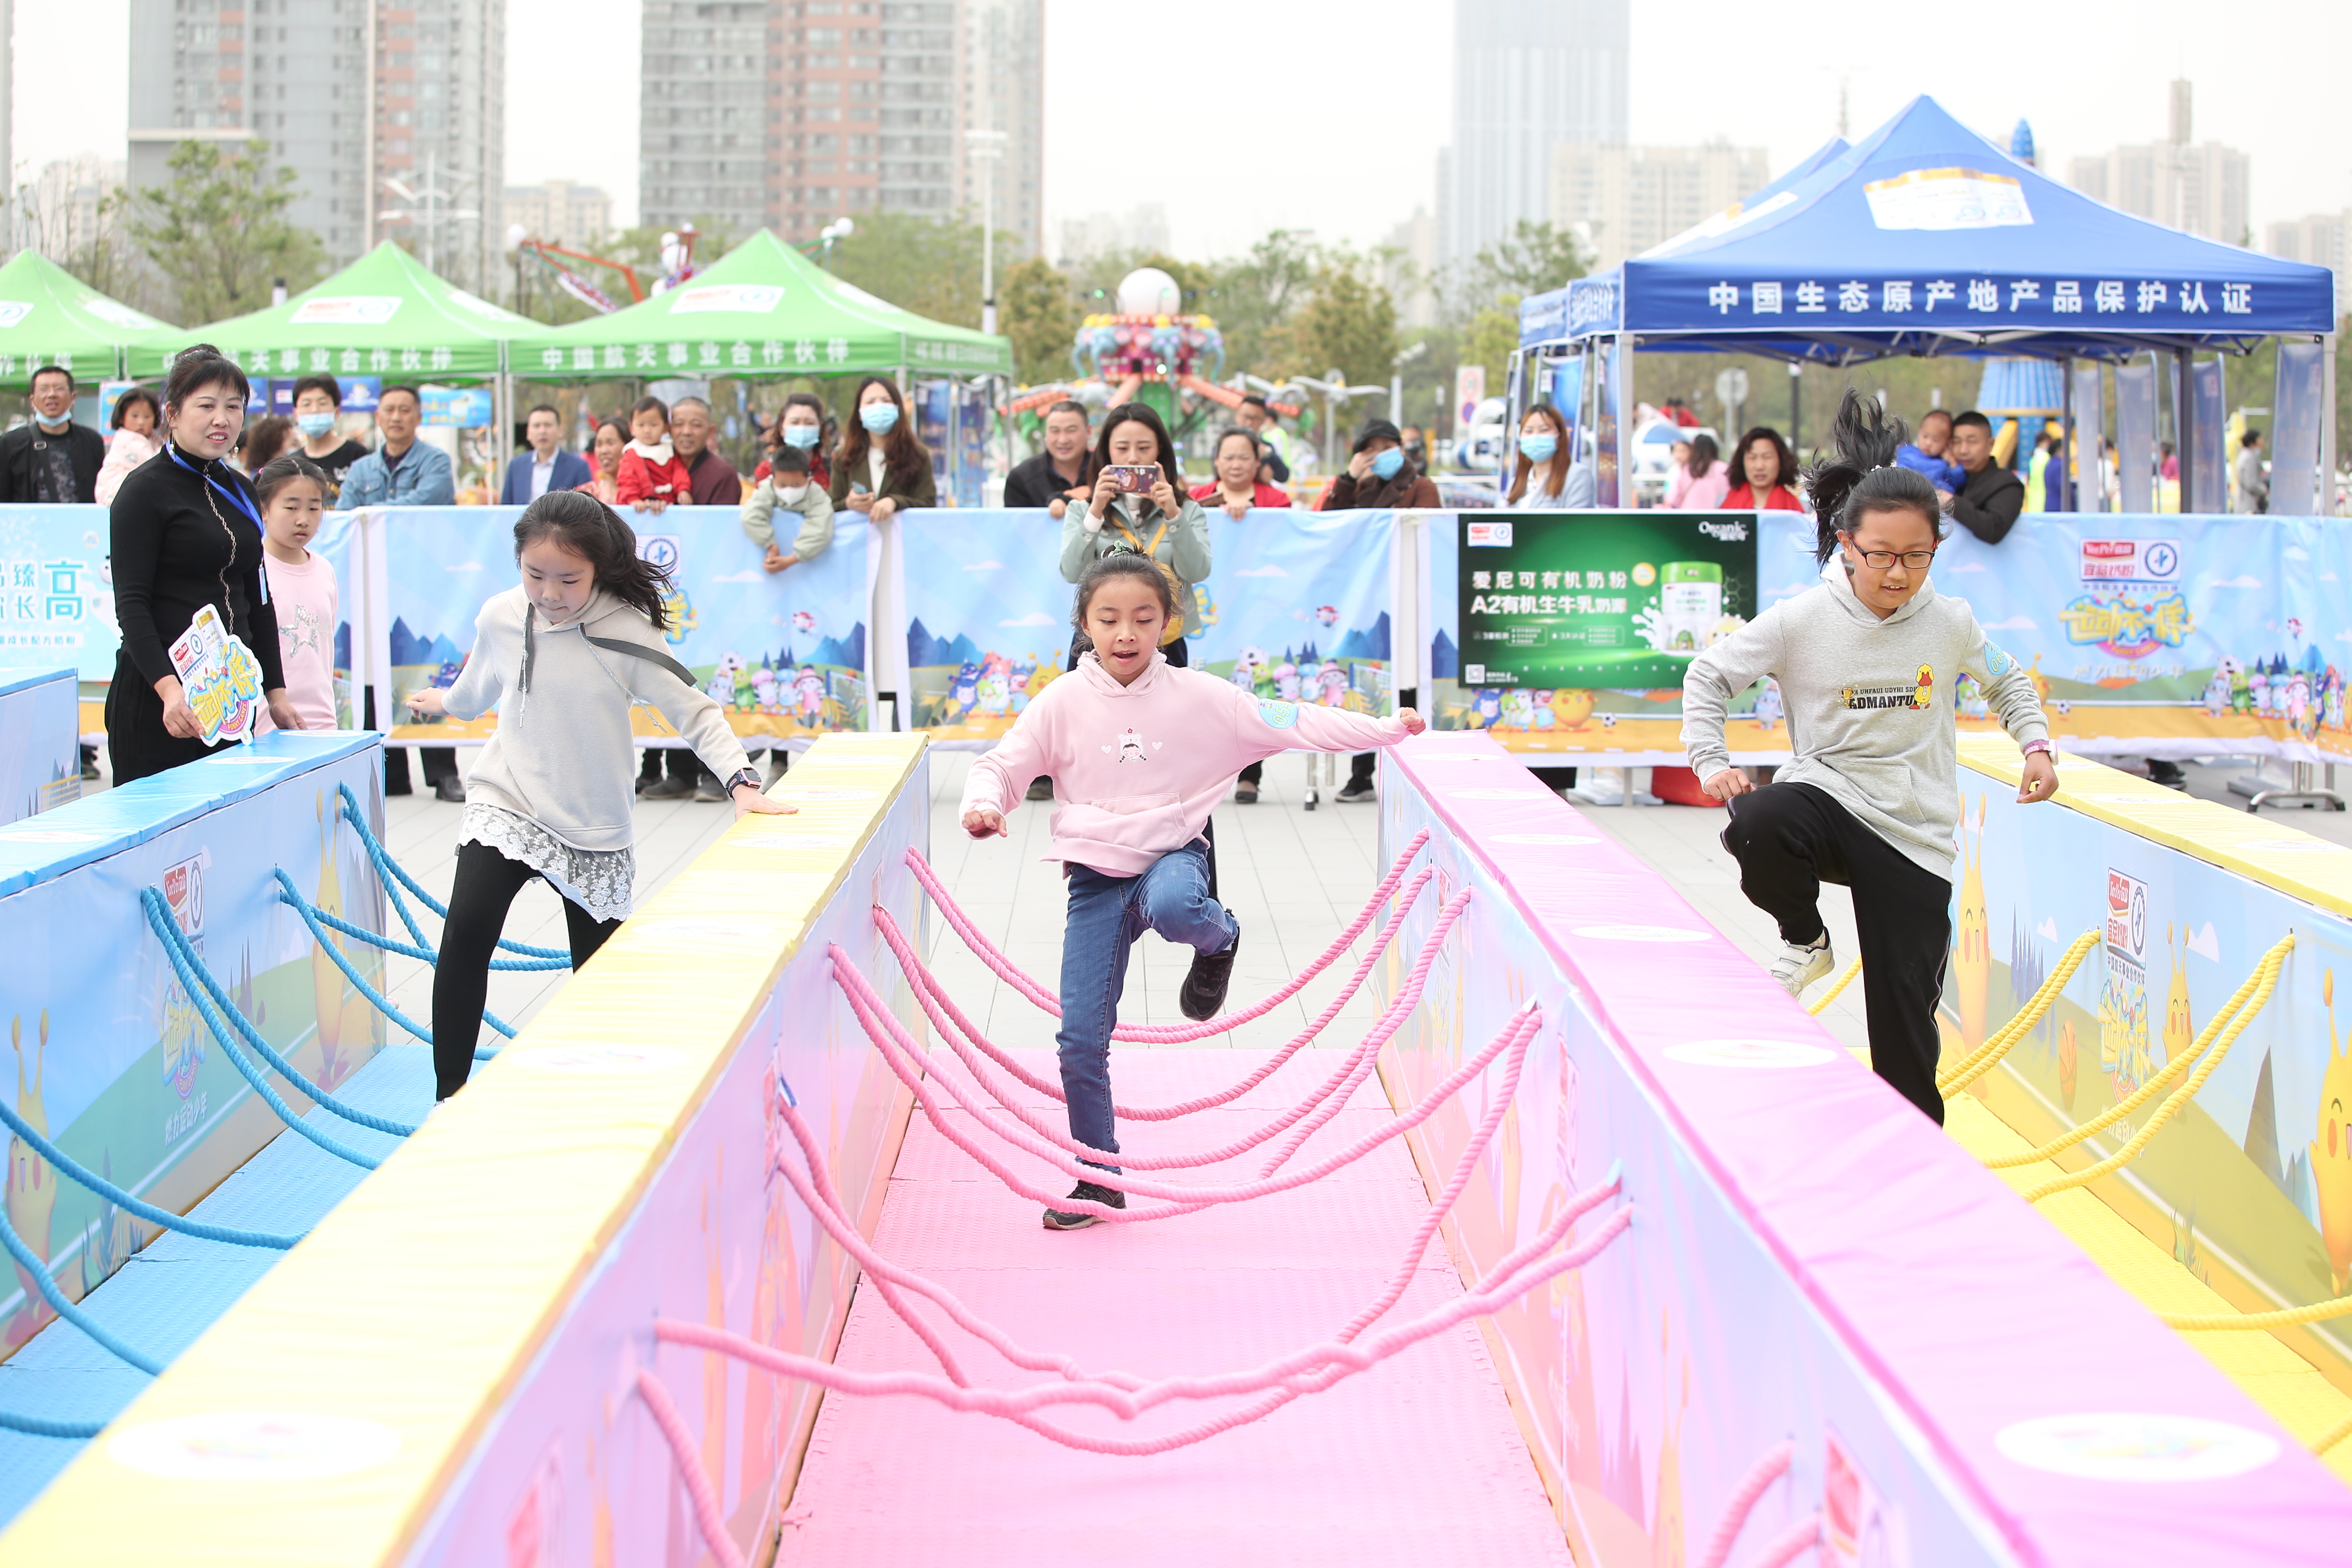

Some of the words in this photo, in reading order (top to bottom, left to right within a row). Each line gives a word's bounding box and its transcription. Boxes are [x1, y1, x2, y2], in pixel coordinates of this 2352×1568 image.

[1708, 279, 2252, 315] 中国生态原产地产品保护认证
[542, 337, 849, 371] 中国航天事业合作伙伴
[44, 560, 83, 620] 高
[1472, 570, 1627, 590] 爱尼可有机奶粉
[227, 719, 240, 730] FUNNY
